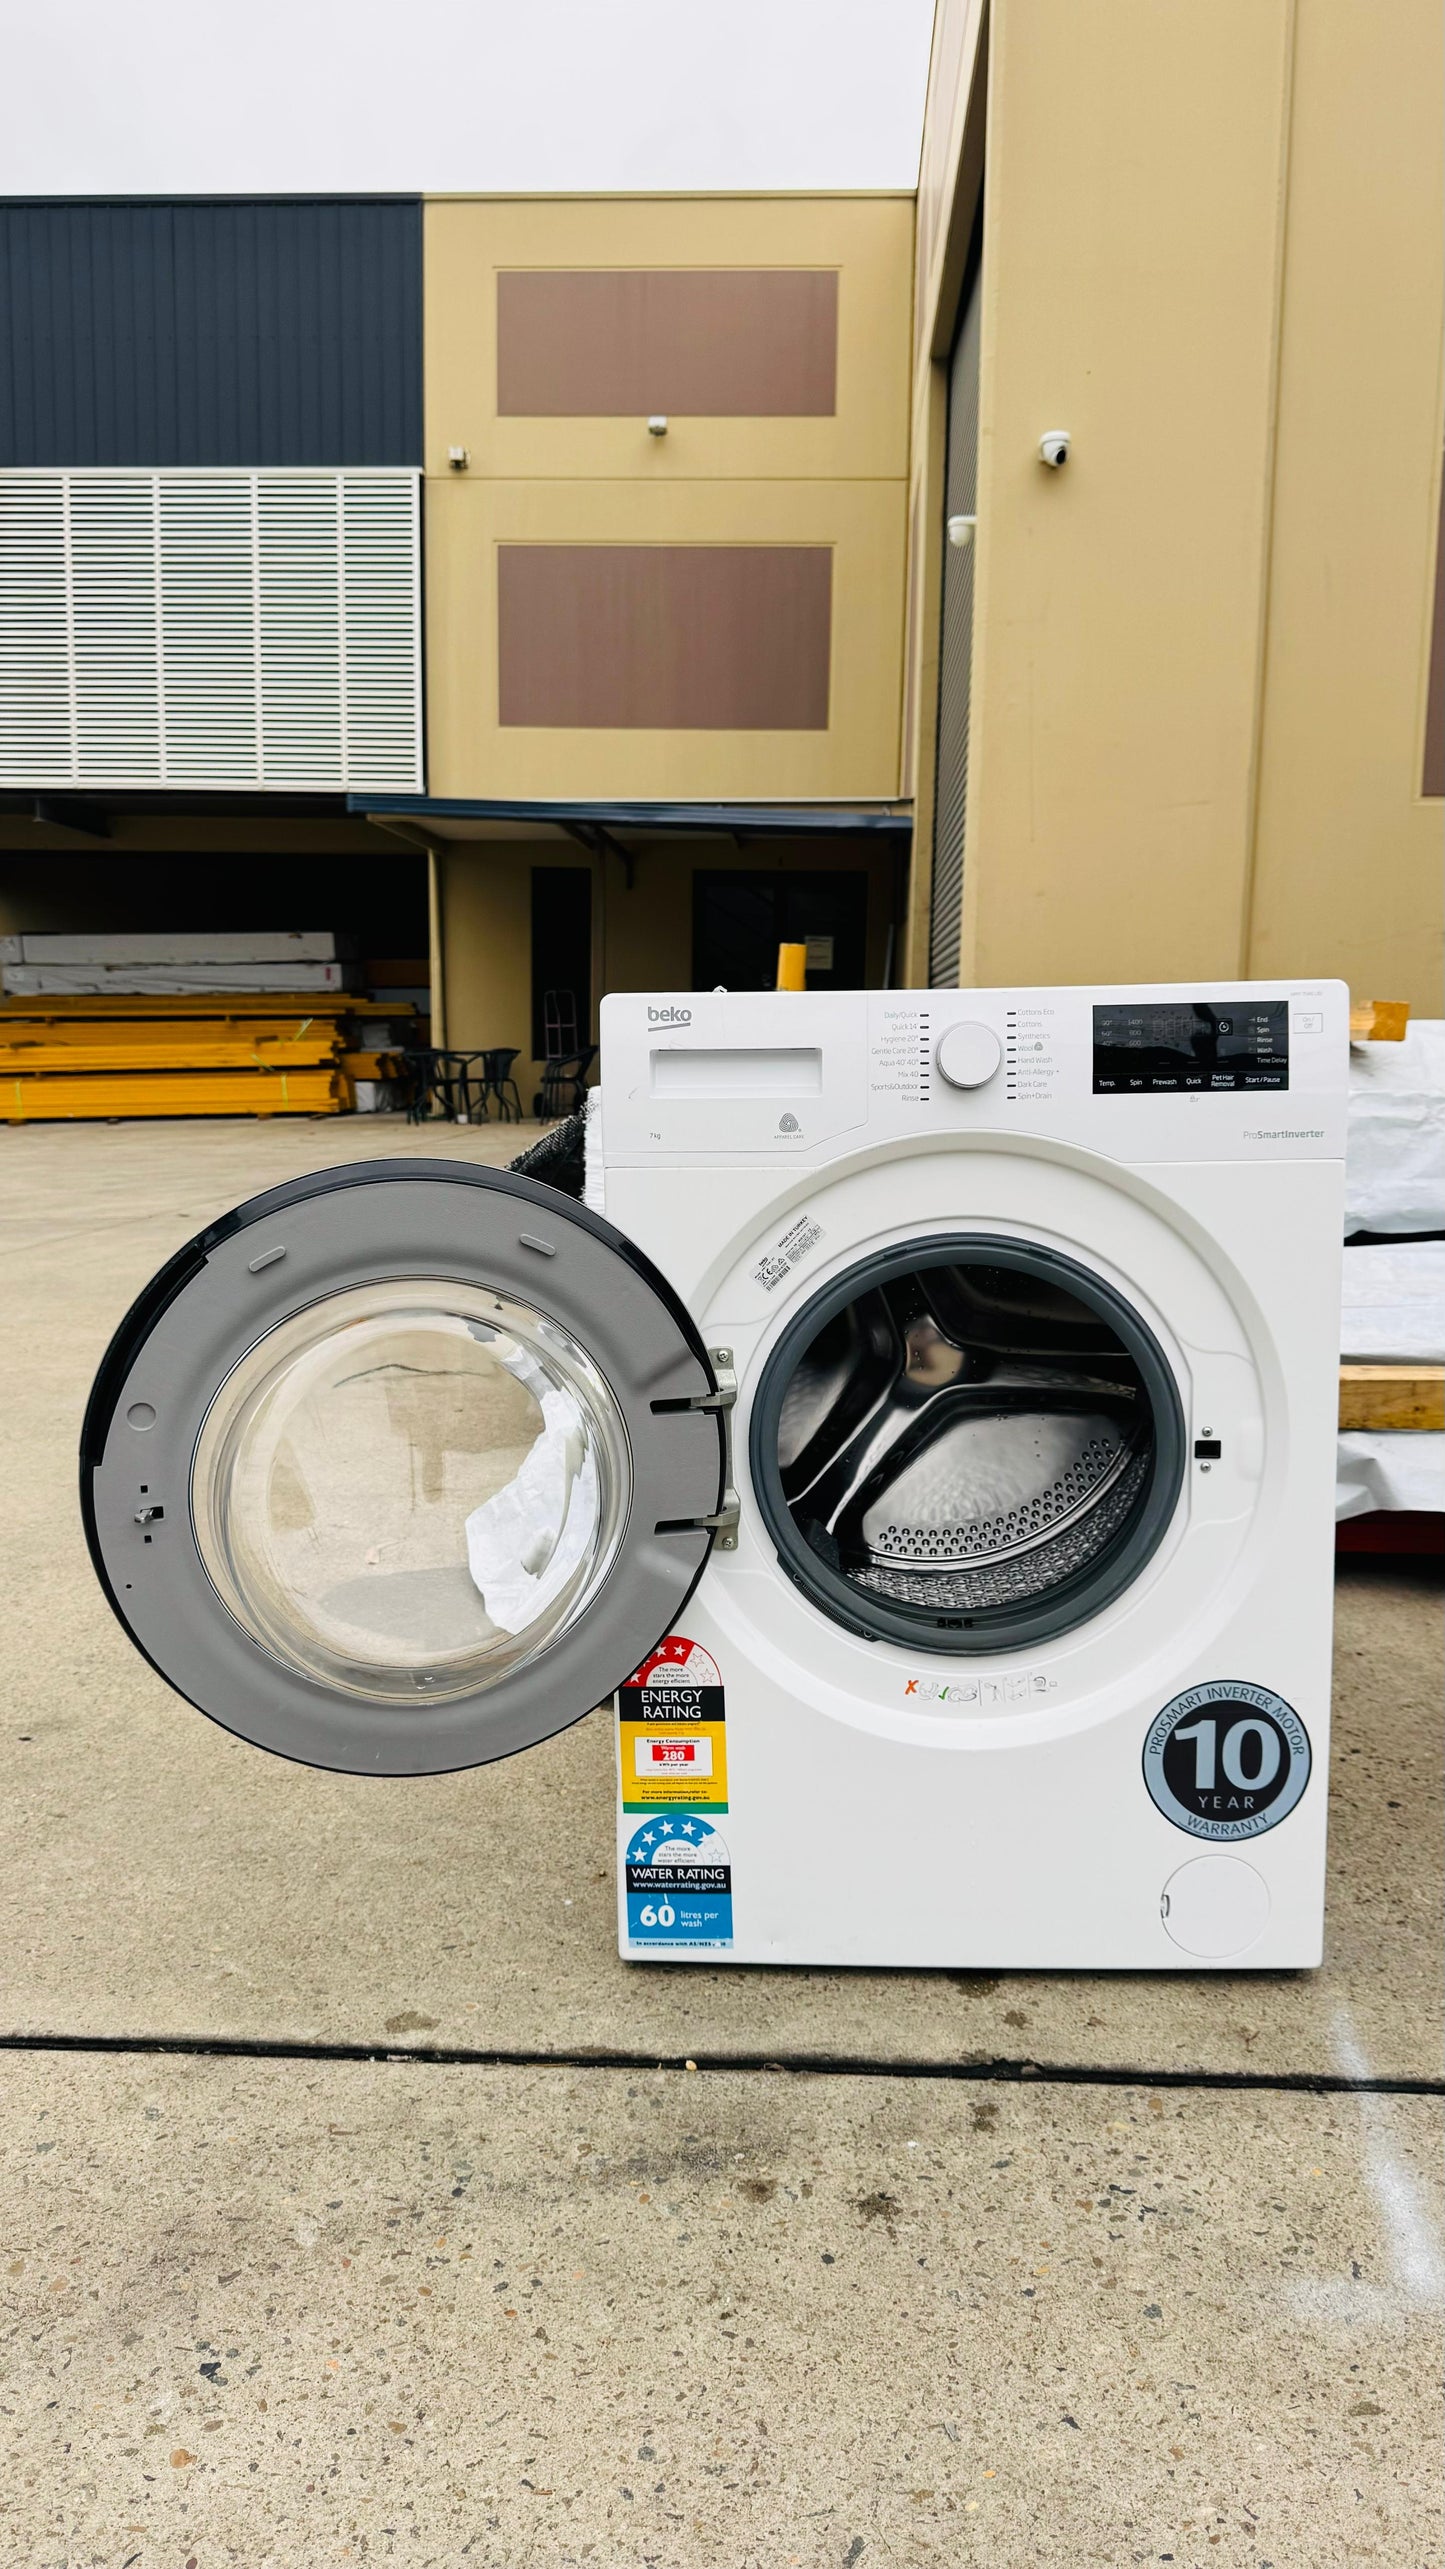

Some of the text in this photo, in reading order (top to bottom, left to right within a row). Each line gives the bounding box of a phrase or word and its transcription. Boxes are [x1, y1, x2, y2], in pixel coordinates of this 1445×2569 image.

[648, 1006, 692, 1022] beko
[880, 1036, 906, 1044] Hygiene
[1018, 1032, 1051, 1040] Synthetics
[870, 1083, 918, 1091] Sports&Outdoor
[1243, 1130, 1325, 1139] ProSmartInverter
[778, 1236, 789, 1248] MADE
[793, 1216, 808, 1232] TURKEY
[641, 1690, 702, 1703] ENERGY
[643, 1706, 702, 1719] RATING
[1150, 1686, 1304, 1755] PROSMART INVERTER MOTOR
[662, 1751, 685, 1760] 280
[1174, 1718, 1281, 1791] 10
[1198, 1796, 1254, 1808] YEAR
[1187, 1813, 1269, 1835] WARRANTY
[631, 1868, 725, 1880] WATER RATING
[633, 1881, 726, 1890] www.waterrating.gov.au
[640, 1904, 675, 1927] 60
[680, 1911, 719, 1921] litres per
